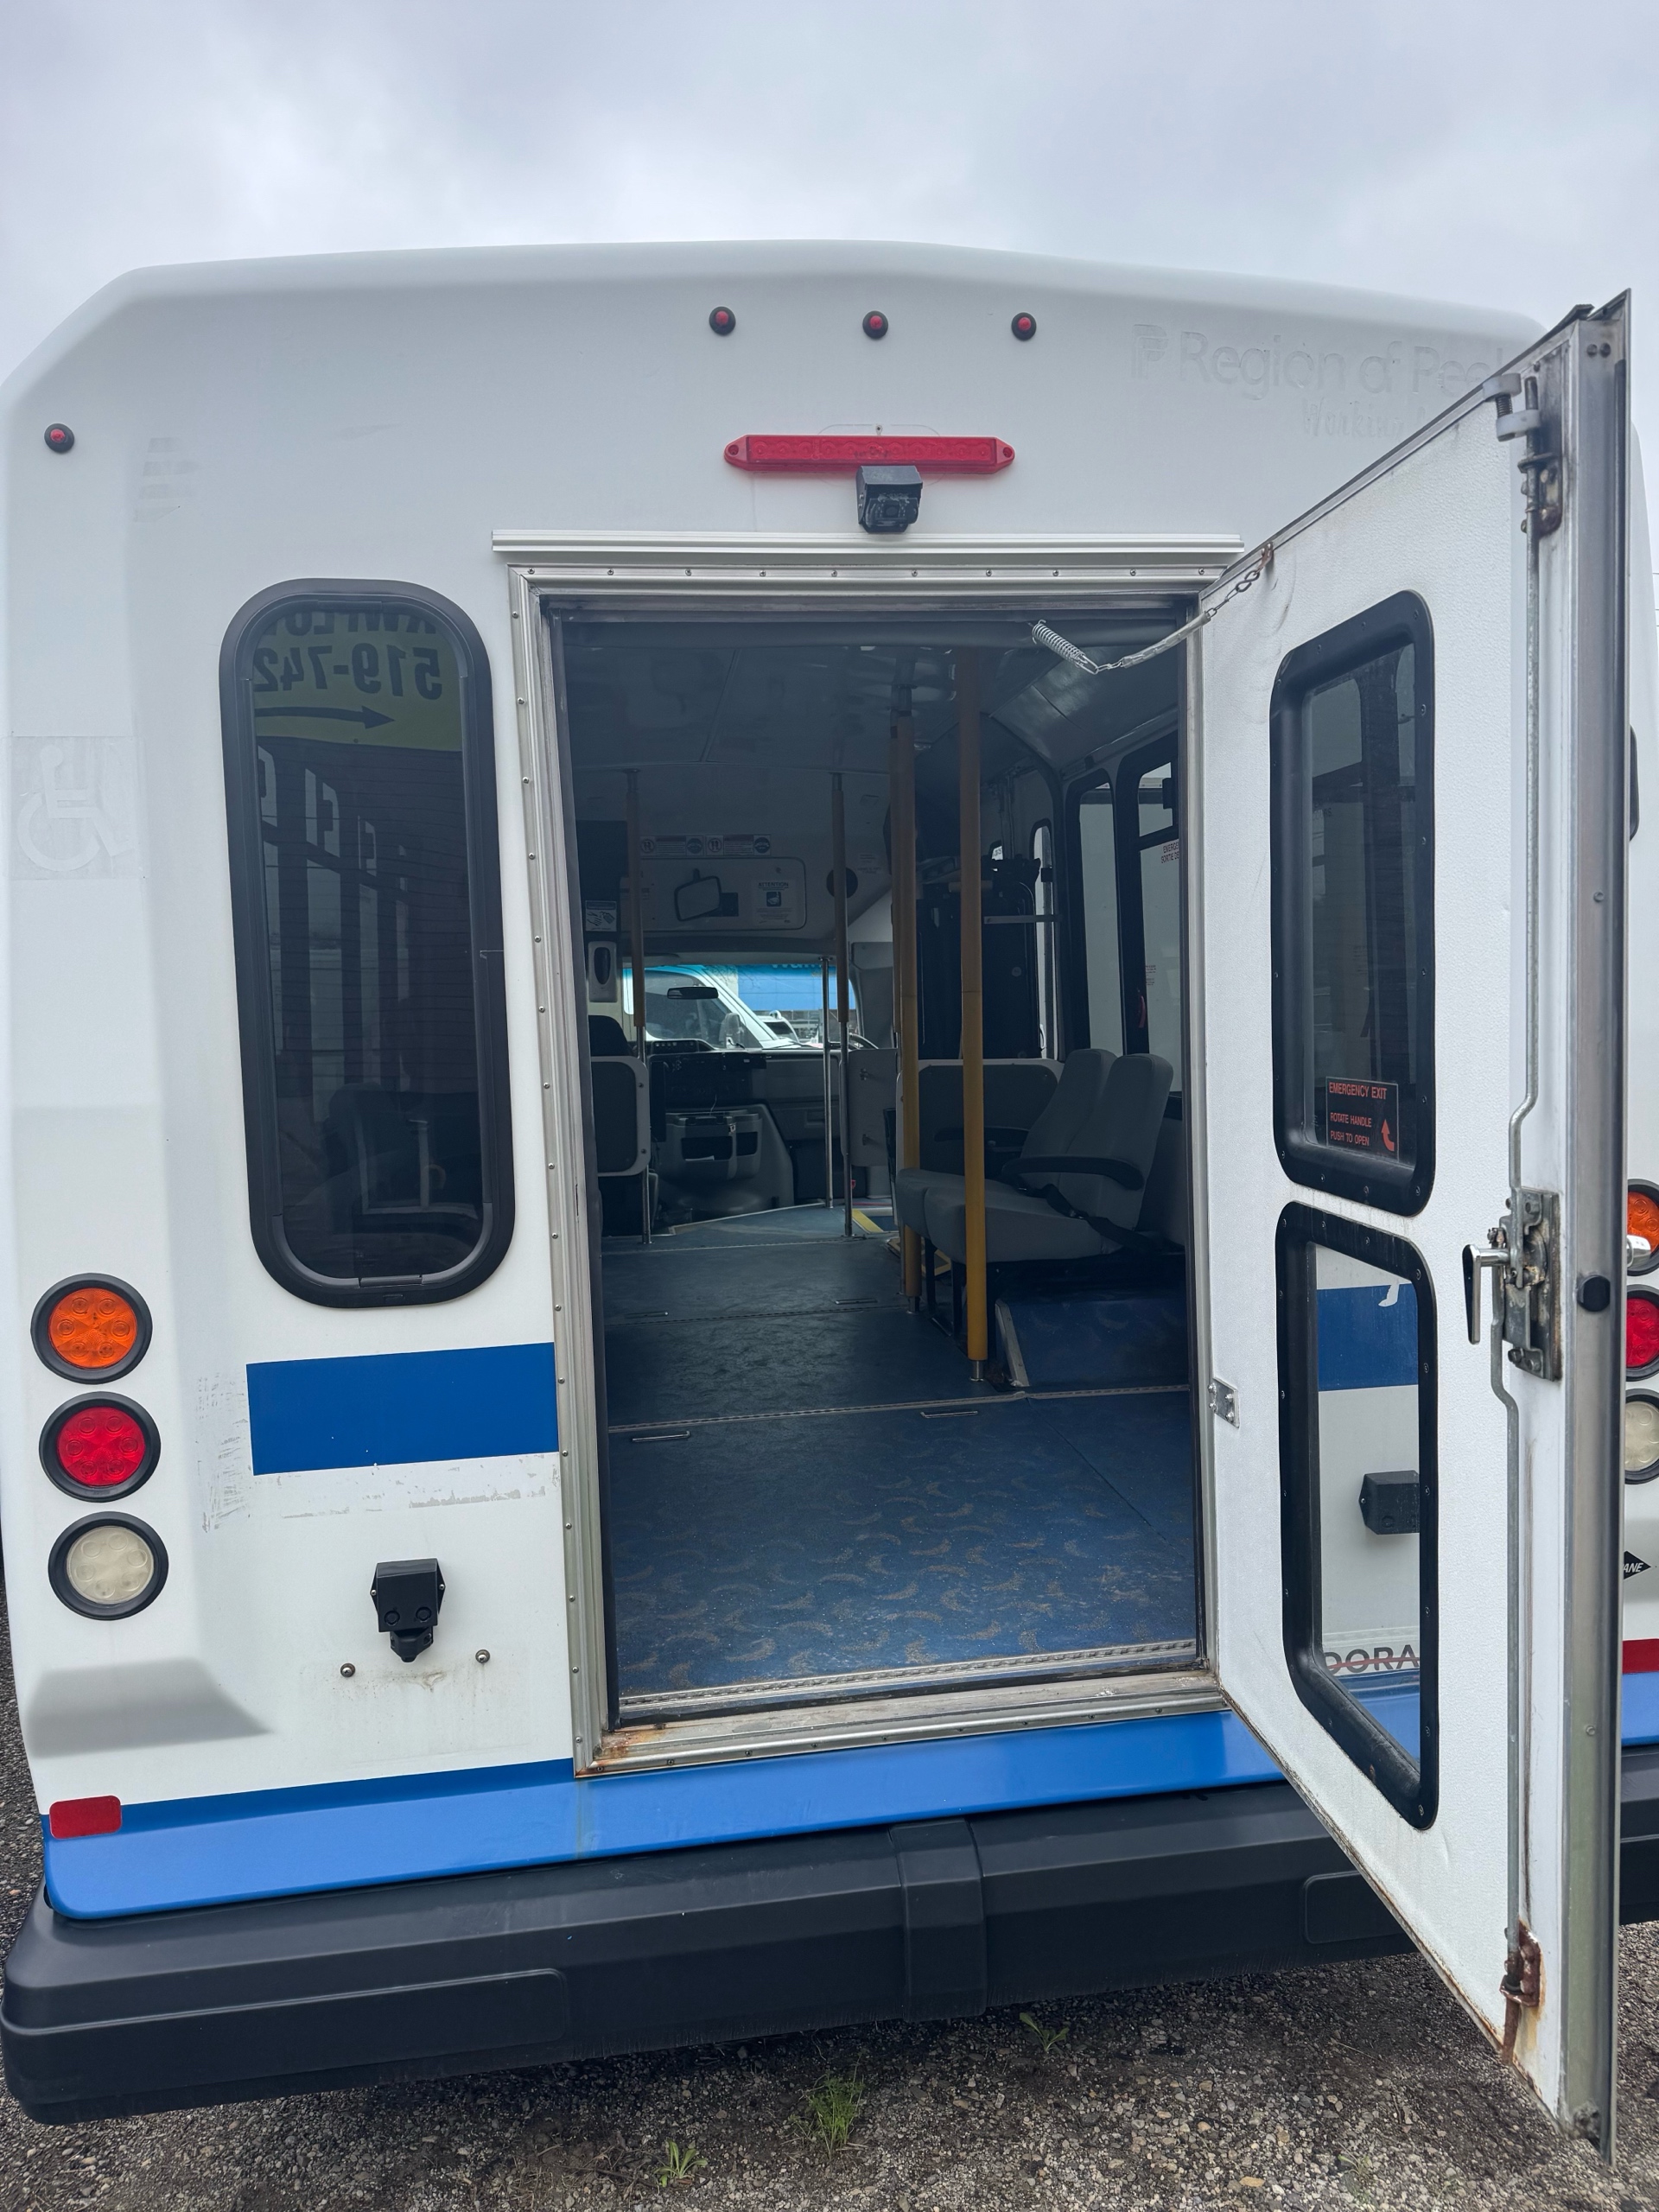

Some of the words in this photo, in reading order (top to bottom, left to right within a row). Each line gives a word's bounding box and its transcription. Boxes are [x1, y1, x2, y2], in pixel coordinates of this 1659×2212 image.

[1179, 331, 1346, 401] Region
[1359, 340, 1402, 395] of
[1329, 1082, 1370, 1097] EMERGENCY
[1371, 1086, 1388, 1100] EXIT
[1330, 1112, 1349, 1124] ROTATE
[1350, 1115, 1372, 1128] HANDLE
[1330, 1130, 1344, 1141] PUSH
[1345, 1133, 1353, 1143] TO
[1354, 1135, 1370, 1147] OPEN
